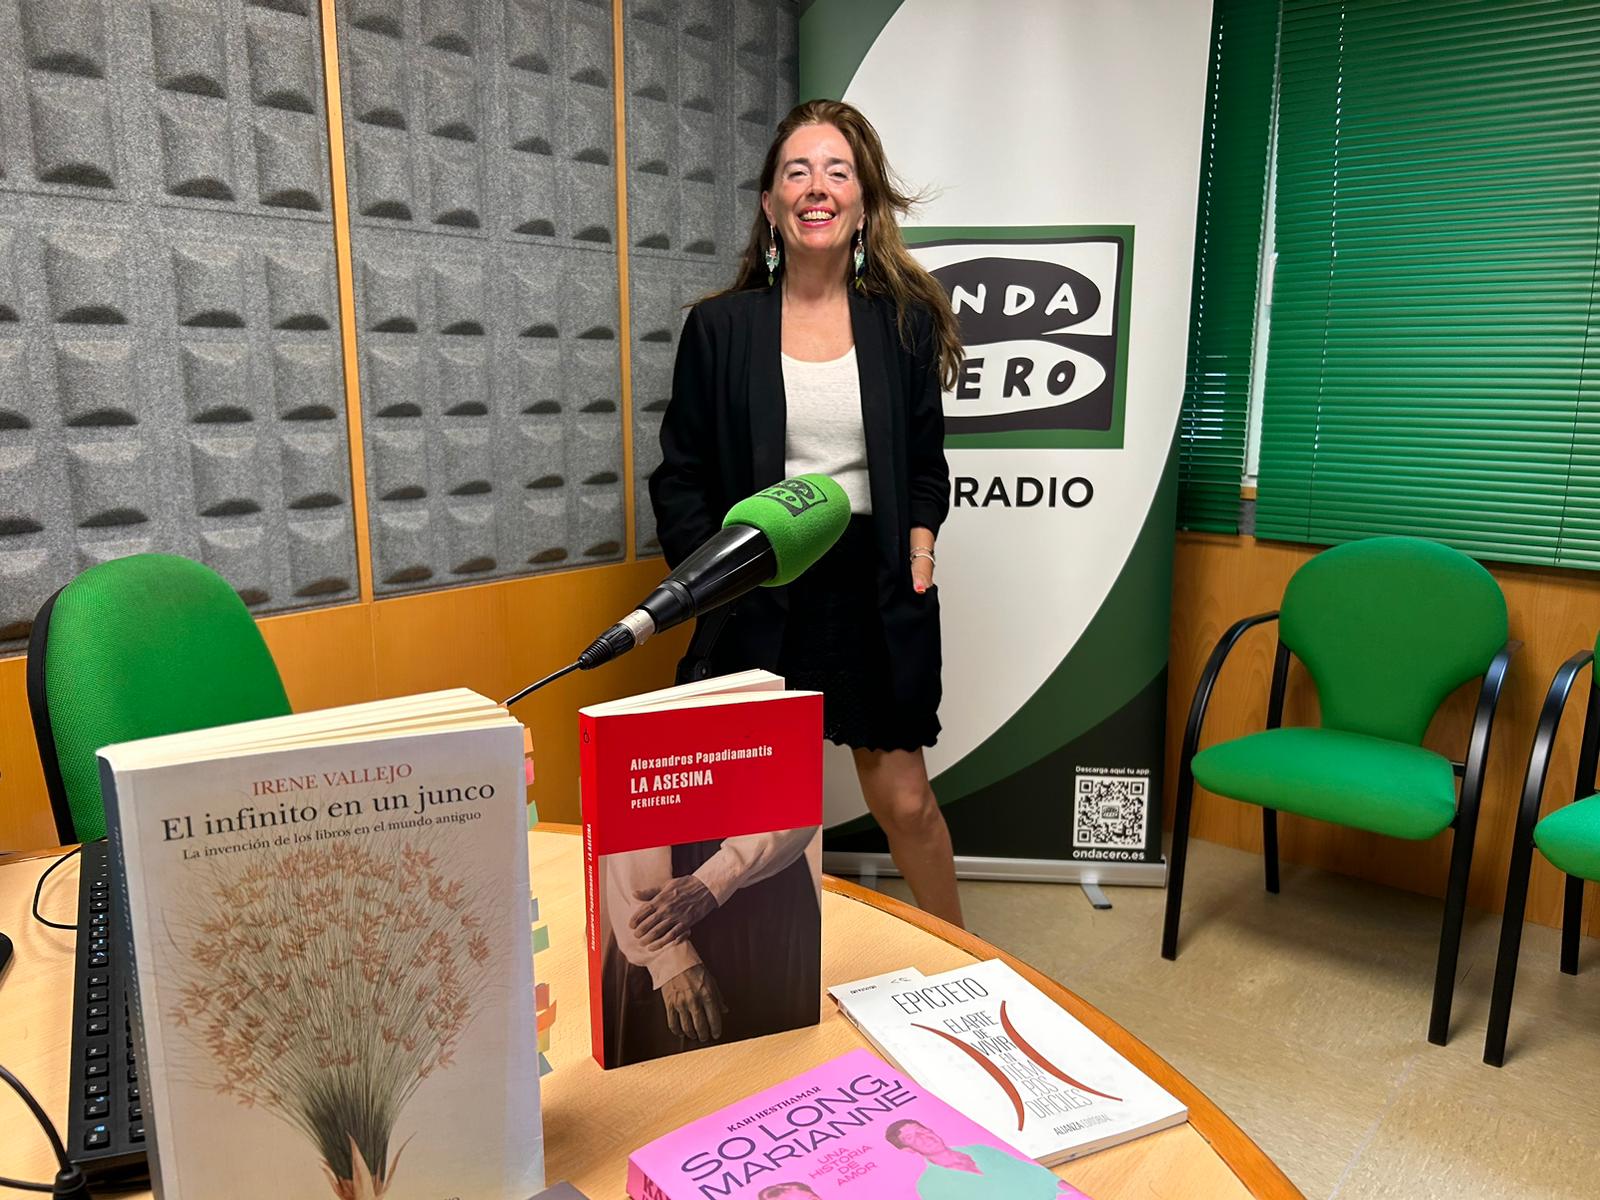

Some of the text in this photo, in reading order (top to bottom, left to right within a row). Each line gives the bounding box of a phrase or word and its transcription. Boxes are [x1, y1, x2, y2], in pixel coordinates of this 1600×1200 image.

[951, 282, 1079, 317] NDA
[955, 356, 1077, 401] ERO
[953, 476, 1094, 508] RADIO
[630, 745, 773, 771] Alexandros Papadiamantis
[1075, 765, 1108, 774] Descarga
[1135, 768, 1150, 776] app
[252, 762, 414, 797] IRENE VALLEJO
[630, 769, 714, 794] LA ASESINA
[161, 782, 496, 843] El infinito en un junco
[183, 811, 482, 860] La invención de los libros en el mundo antiguo
[1072, 848, 1145, 860] ondacero.es
[891, 977, 990, 1016] EPICTETO
[943, 1010, 999, 1034] EL ARTE
[972, 1028, 991, 1041] DE
[971, 1035, 1017, 1056] VIVIR
[999, 1052, 1017, 1064] EN
[1000, 1059, 1045, 1082] TIEM
[1021, 1075, 1059, 1097] POS
[726, 1085, 821, 1133] KARI HESTHAMAR
[1053, 1121, 1084, 1136] ALIANZA
[698, 1086, 918, 1200] MARIANNE
[817, 1147, 849, 1164] UNA
[681, 1136, 756, 1182] SO
[808, 1145, 873, 1179] HISTORIA
[838, 1161, 860, 1174] DE
[837, 1162, 877, 1186] AMOR
